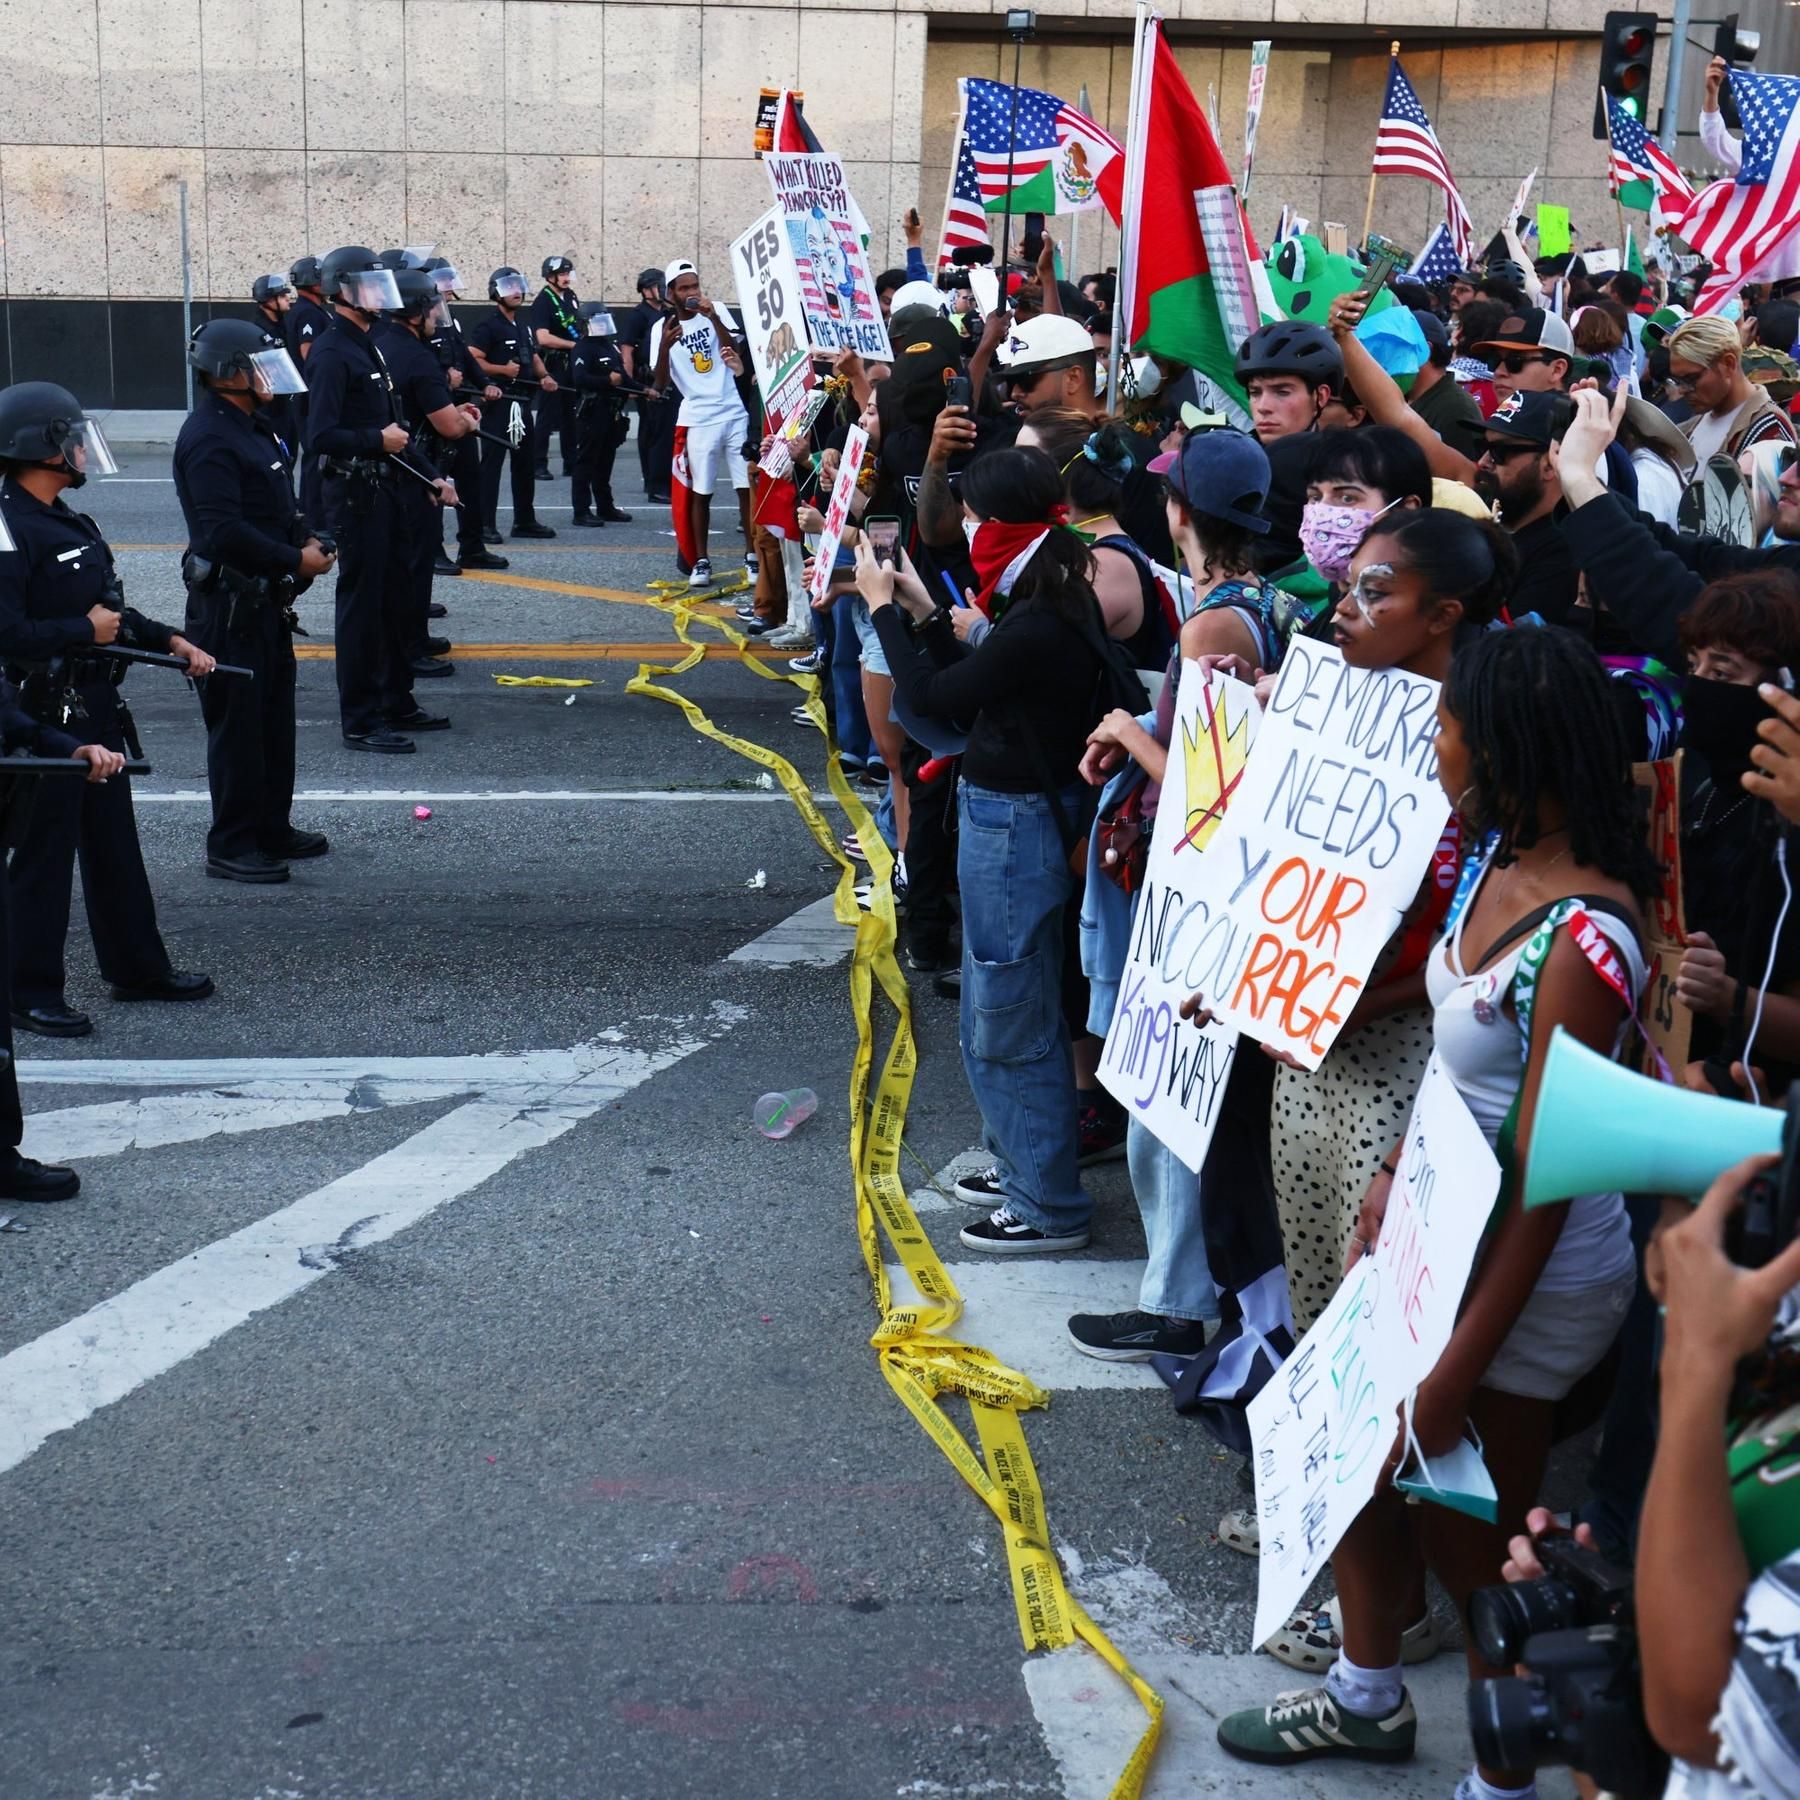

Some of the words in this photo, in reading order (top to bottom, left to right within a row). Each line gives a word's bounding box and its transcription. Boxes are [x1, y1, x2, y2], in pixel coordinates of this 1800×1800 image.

[769, 159, 804, 190] WHAT
[804, 159, 842, 191] KILLED
[777, 189, 848, 219] DEMOCRACY?!
[741, 220, 779, 278] YES
[760, 267, 771, 285] ON
[758, 279, 784, 331] 50
[680, 327, 710, 346] WHAT
[687, 339, 710, 354] THE
[809, 318, 833, 347] THE
[855, 324, 886, 354] AGE!
[1270, 645, 1439, 781] DEMOCRA
[1264, 748, 1417, 870] NEEDS
[1228, 835, 1368, 956] YOUR
[1163, 900, 1362, 1057] COURAGE
[1166, 1021, 1235, 1128] WAY
[915, 1269, 932, 1287] POLICE
[887, 1313, 918, 1325] LINEA
[954, 1384, 968, 1395] DO
[968, 1385, 987, 1401] NOT
[1288, 1343, 1320, 1420] ALL
[993, 1448, 1010, 1470] POLICE
[1005, 1441, 1020, 1453] LOS
[1303, 1411, 1331, 1483] THE
[999, 1469, 1014, 1482] LINE
[1010, 1453, 1028, 1478] ANGELES
[1021, 1563, 1036, 1593] LINEA
[1036, 1561, 1061, 1625] DEPARTAMENTO
[1026, 1591, 1041, 1605] DE
[1028, 1604, 1046, 1634] POLICIA
